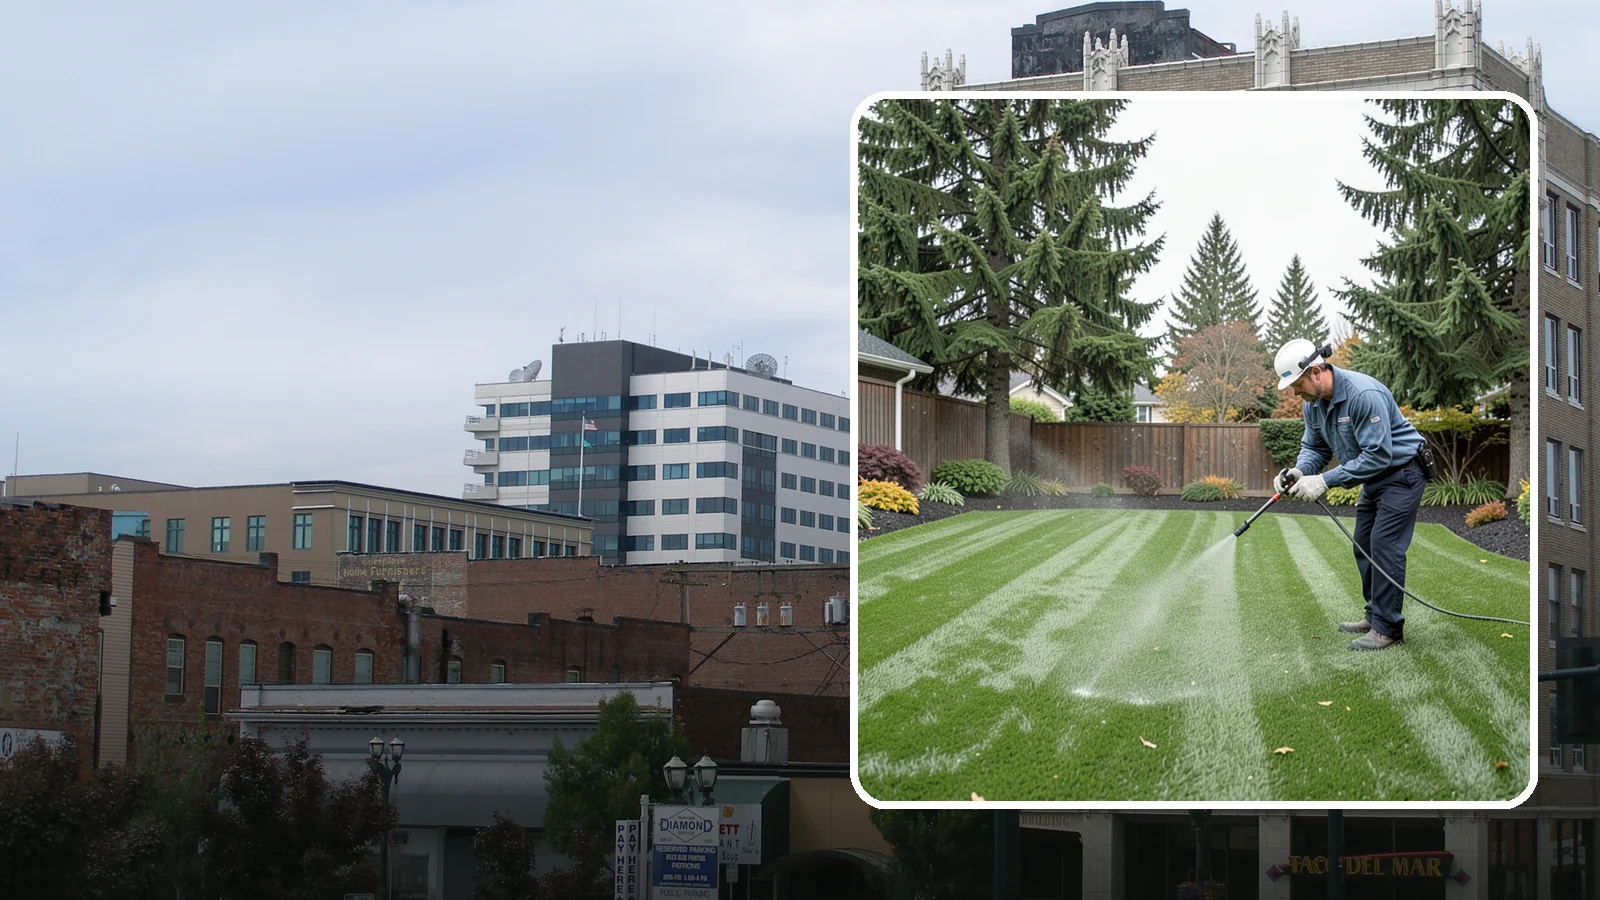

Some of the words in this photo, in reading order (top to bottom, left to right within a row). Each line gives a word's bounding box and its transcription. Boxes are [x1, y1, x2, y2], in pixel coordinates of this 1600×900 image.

[343, 567, 368, 577] Home
[660, 818, 713, 833] DIAMOND
[1022, 815, 1070, 828] BUILDING
[719, 824, 740, 835] ETT
[617, 825, 625, 852] PAY
[628, 825, 637, 852] PAY
[719, 839, 740, 849] ANT
[656, 845, 688, 853] RESERVED
[689, 846, 716, 854] PARKING
[671, 861, 701, 870] PATRONS
[1289, 855, 1329, 874] TAC
[1346, 856, 1385, 876] DEL
[1392, 857, 1443, 877] MAR
[616, 856, 625, 893] HERE
[627, 856, 636, 893] HERE
[662, 873, 682, 881] MON-FRI
[660, 888, 682, 897] PUBLIC
[683, 889, 710, 898] PARKING
